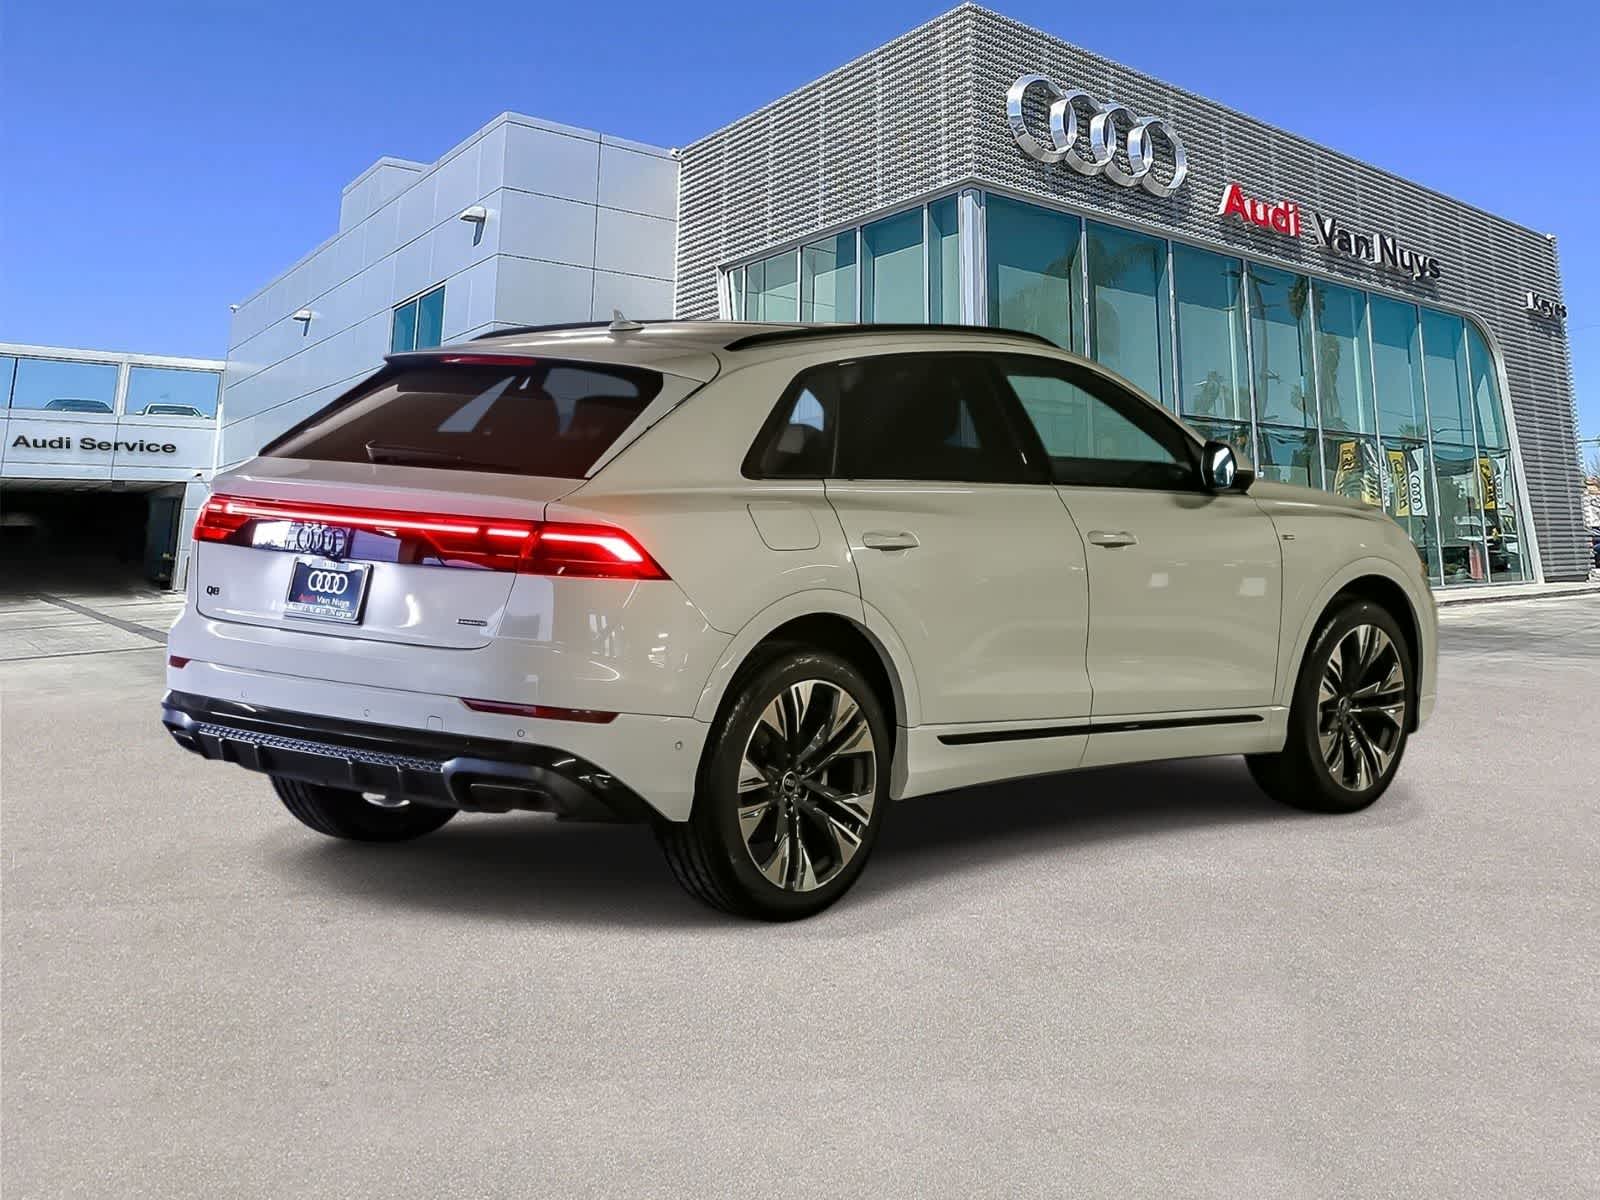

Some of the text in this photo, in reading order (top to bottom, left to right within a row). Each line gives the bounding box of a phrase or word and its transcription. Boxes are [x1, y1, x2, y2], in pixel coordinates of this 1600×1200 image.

[1218, 183, 1440, 281] Audi Van Nuys
[12, 435, 177, 454] Audi Service
[206, 585, 220, 597] Q8
